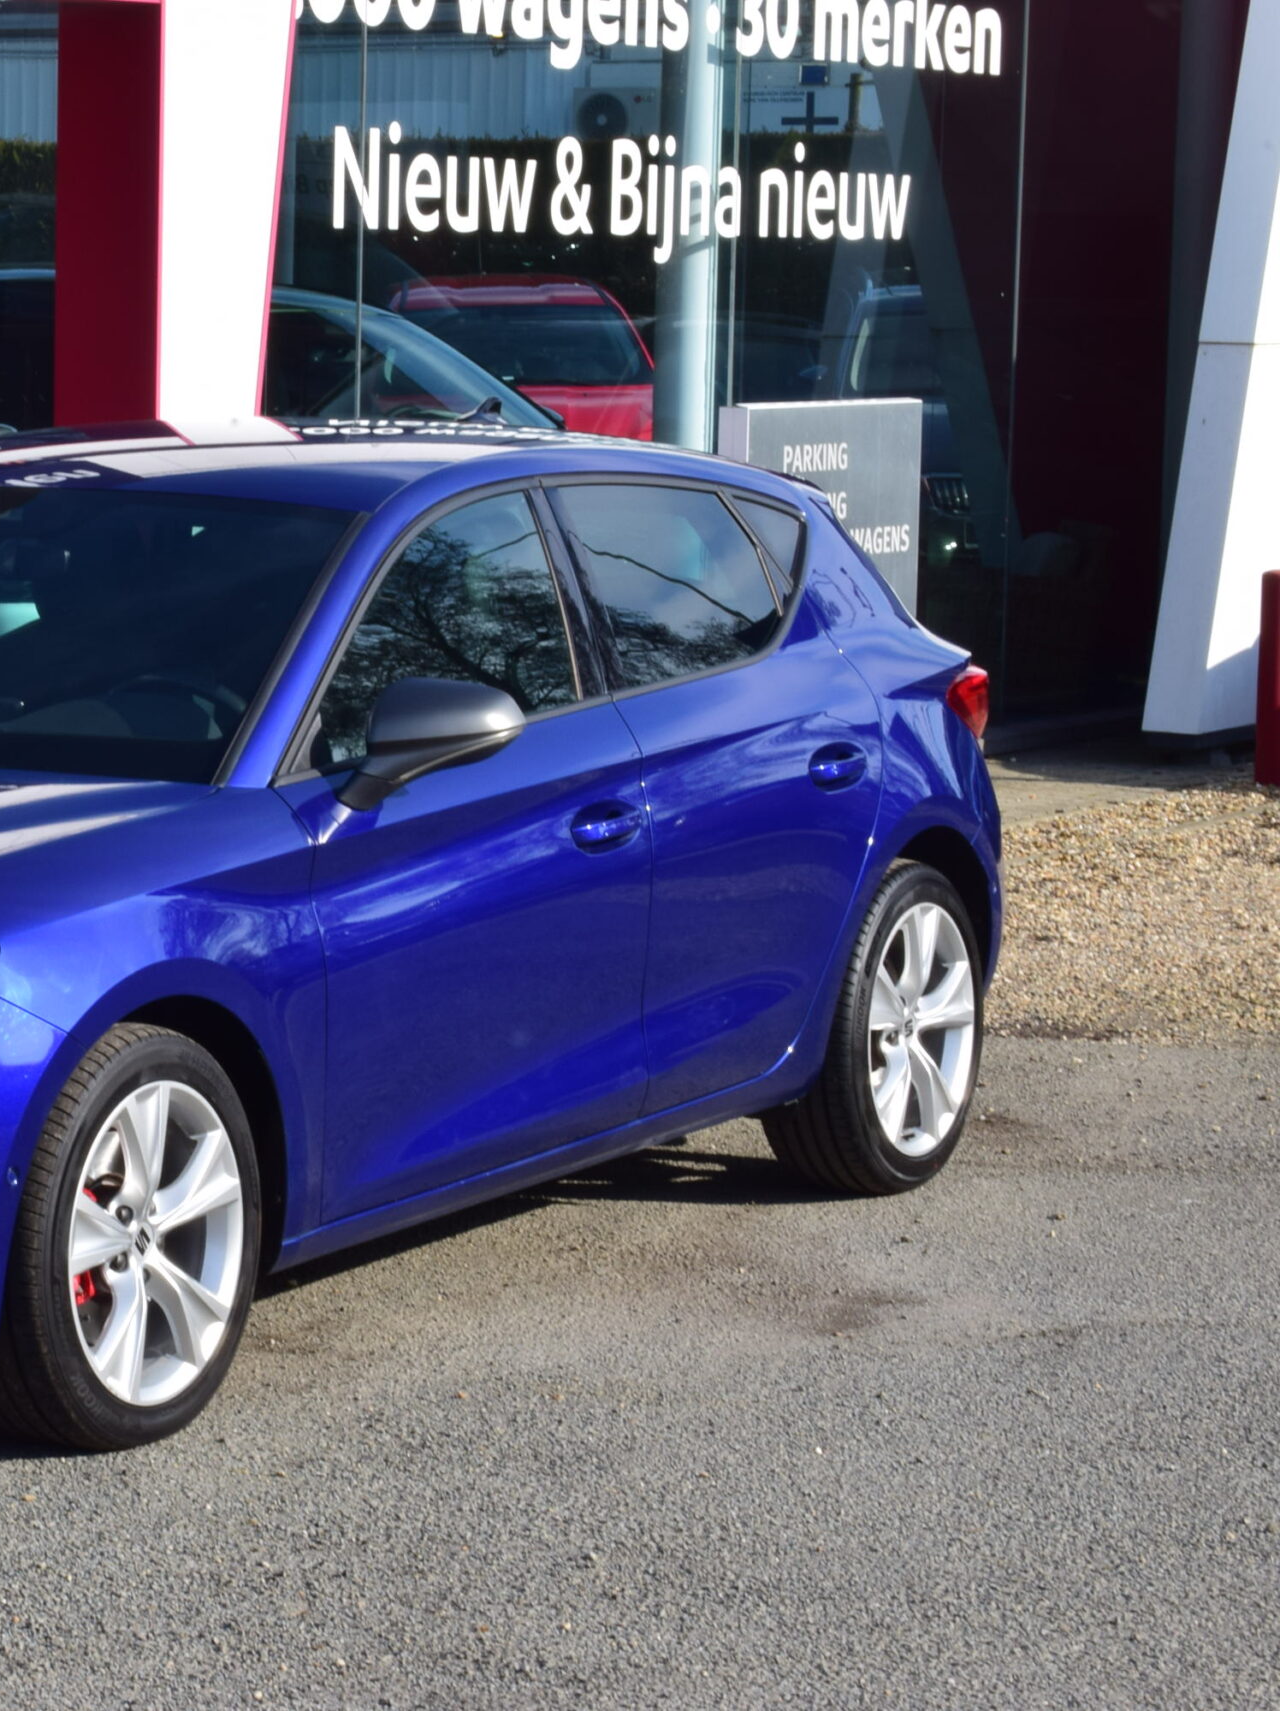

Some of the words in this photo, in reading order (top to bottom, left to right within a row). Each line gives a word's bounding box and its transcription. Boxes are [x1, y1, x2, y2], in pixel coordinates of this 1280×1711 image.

[813, 0, 1002, 76] merken
[332, 121, 537, 233] Nieuw
[550, 136, 593, 235] &
[610, 134, 742, 264] Bijna
[758, 141, 911, 241] nieuw
[783, 442, 848, 473] PARKING
